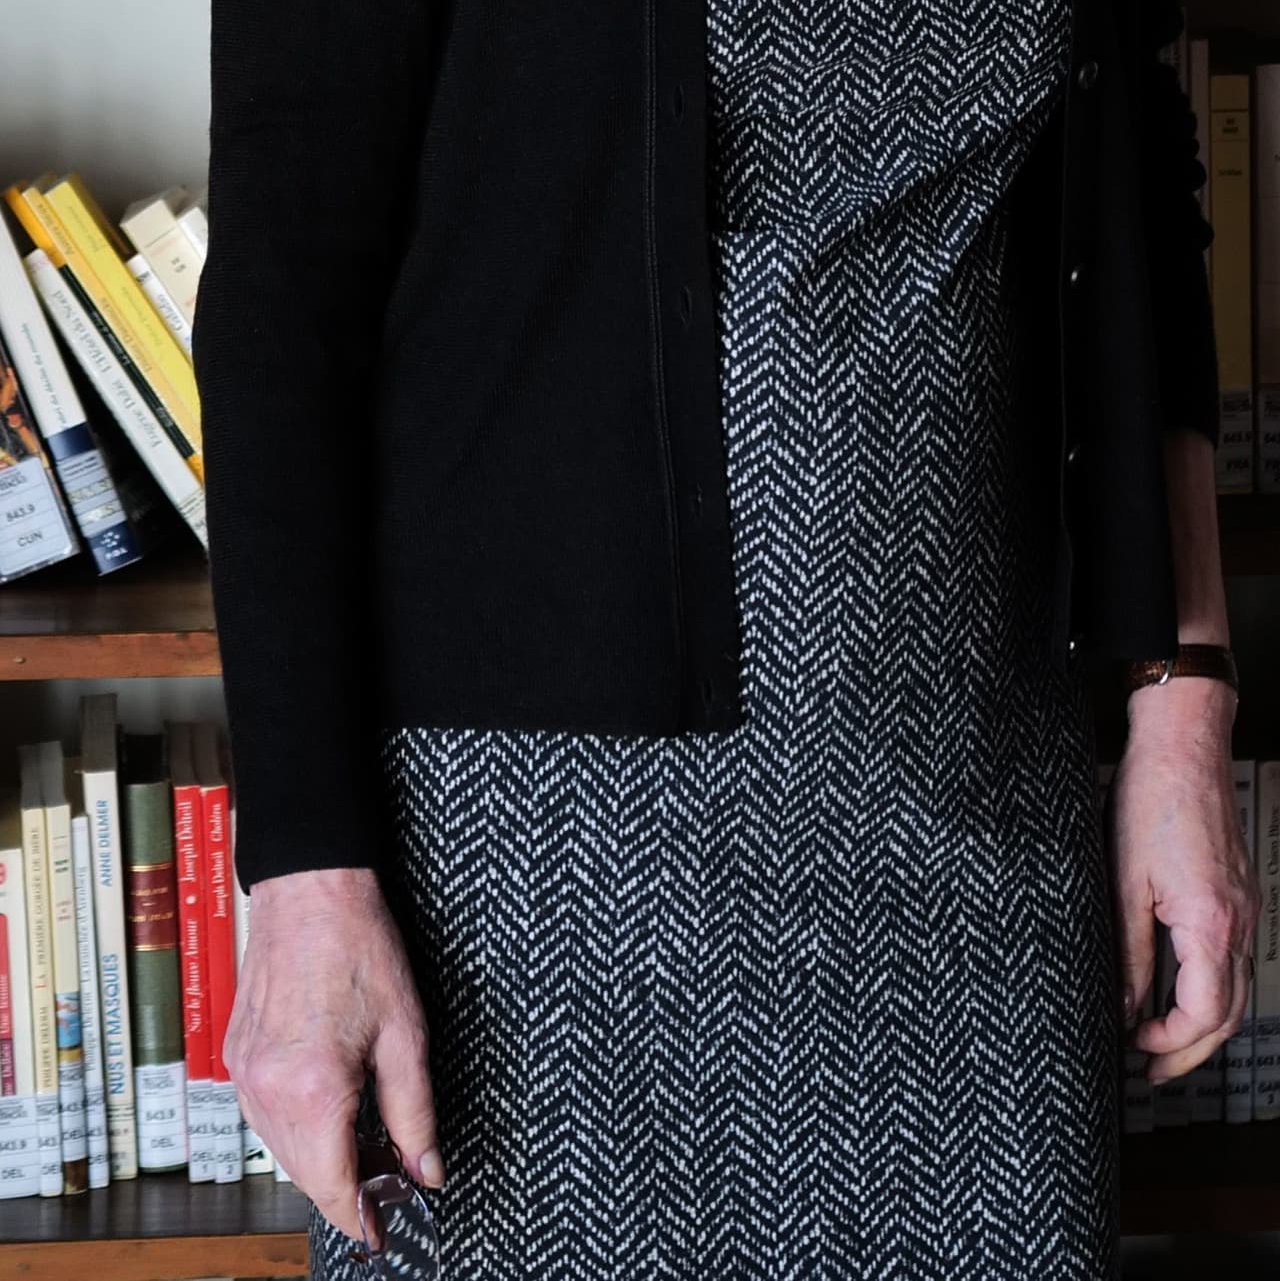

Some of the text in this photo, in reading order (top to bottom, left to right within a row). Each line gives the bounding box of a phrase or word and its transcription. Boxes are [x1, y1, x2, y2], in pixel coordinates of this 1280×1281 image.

[96, 800, 112, 887] ANNE DELMER
[176, 801, 197, 883] Joseph Delteil
[103, 954, 124, 1094] NUS ET MASQUES
